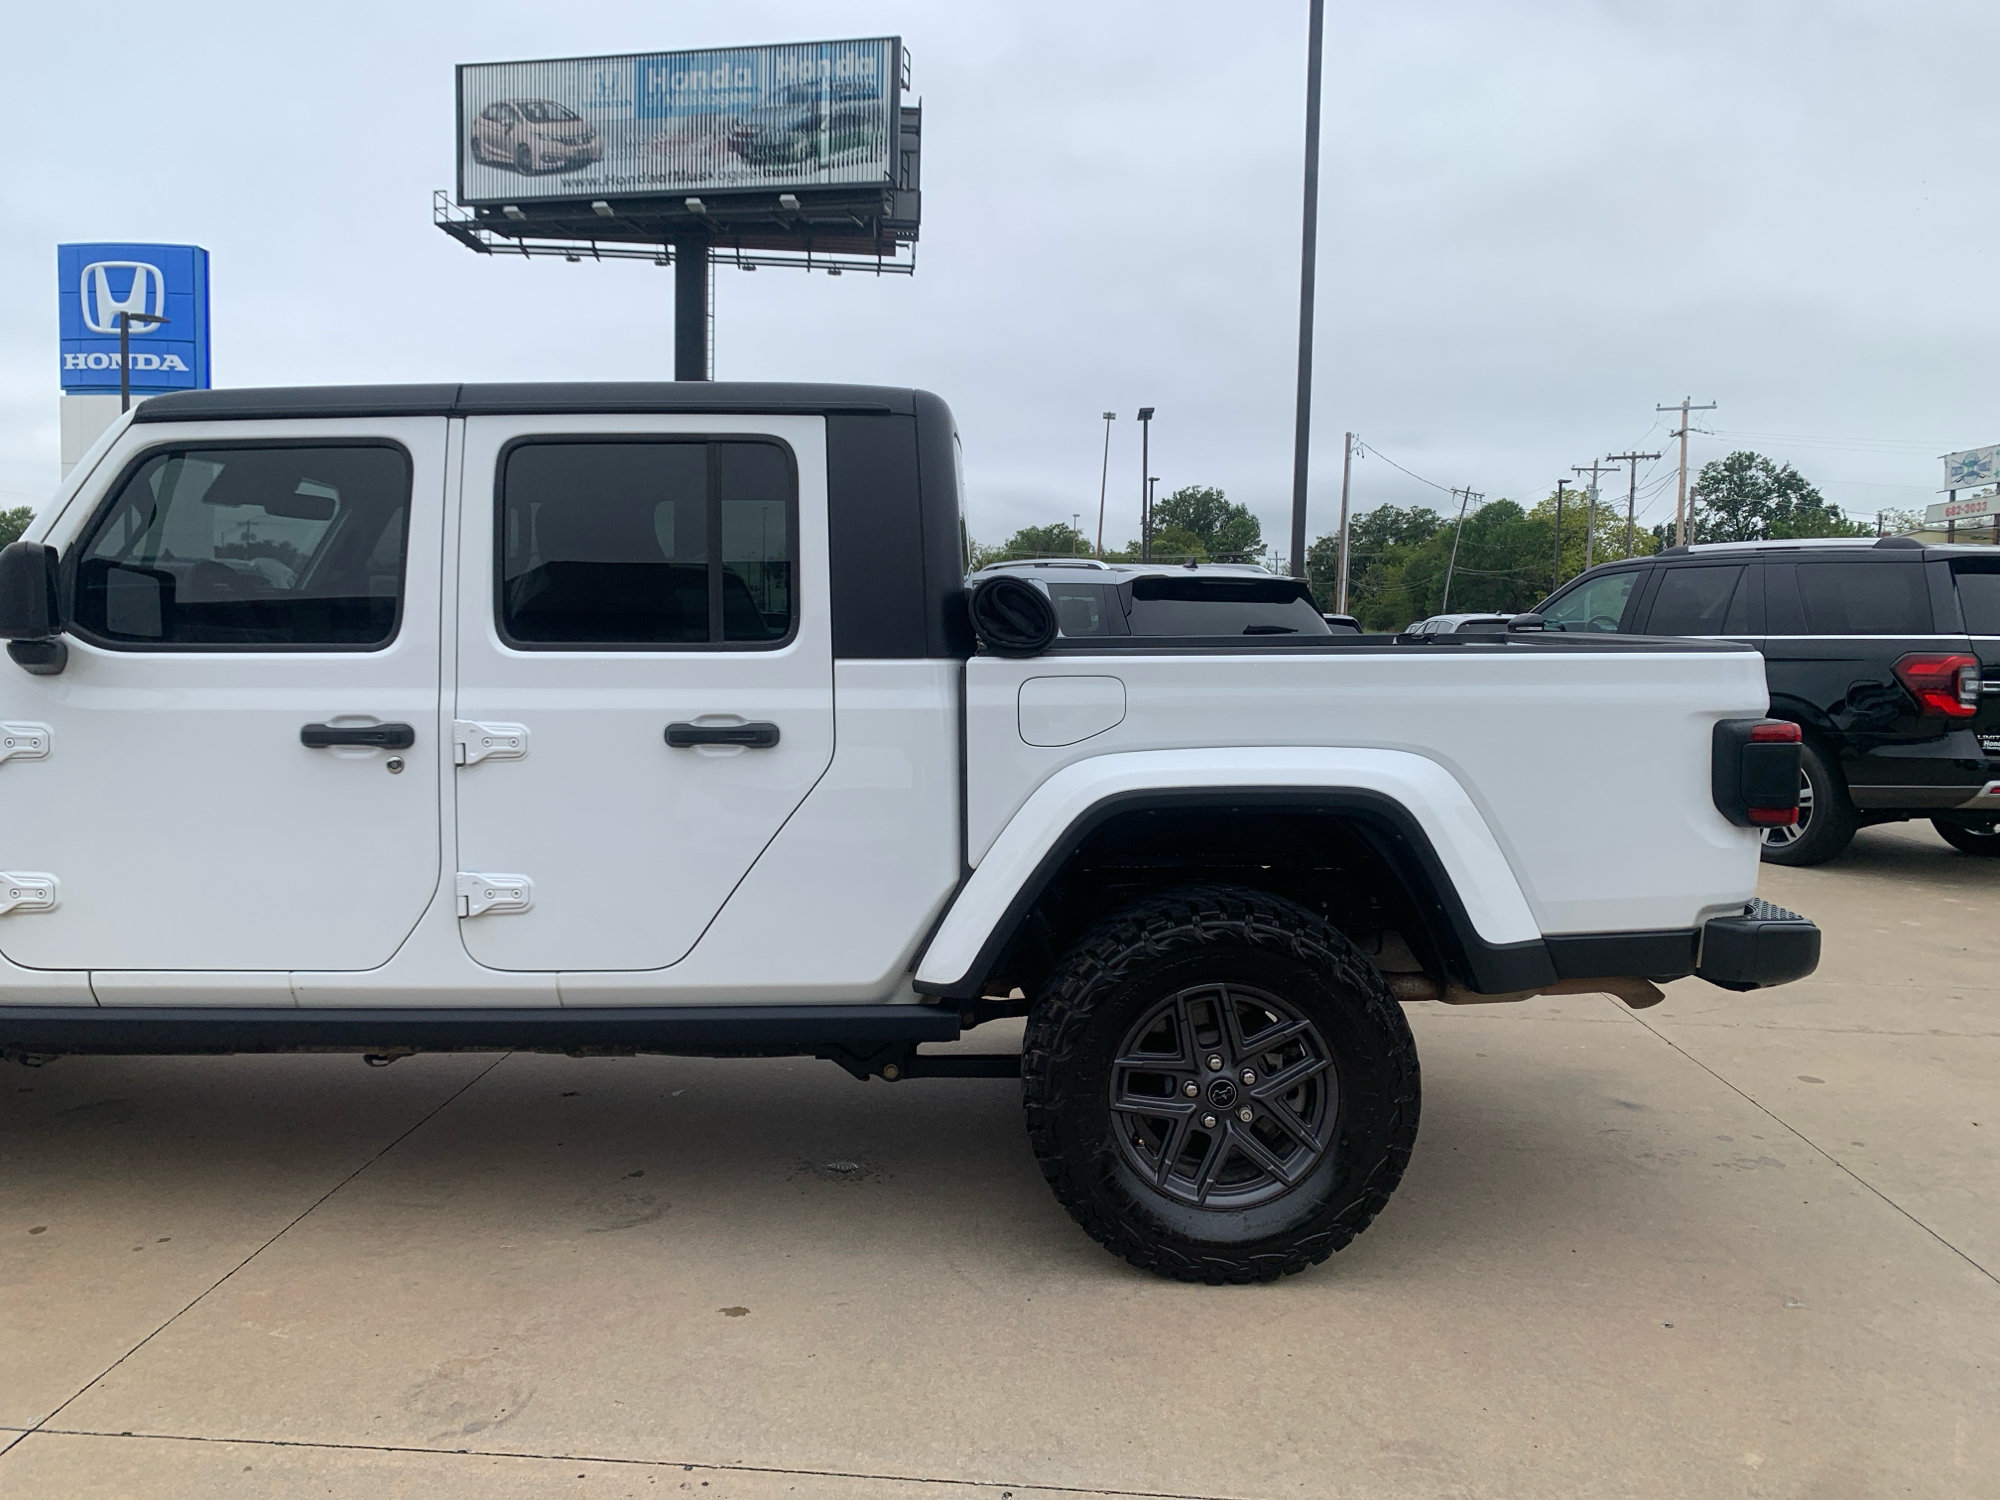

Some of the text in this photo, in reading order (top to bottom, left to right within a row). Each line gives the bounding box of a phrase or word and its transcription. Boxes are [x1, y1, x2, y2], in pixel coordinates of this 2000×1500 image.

[648, 62, 752, 93] Honda
[776, 50, 875, 81] Honda
[63, 352, 189, 371] HONDA
[1945, 502, 1987, 517] 682-3033
